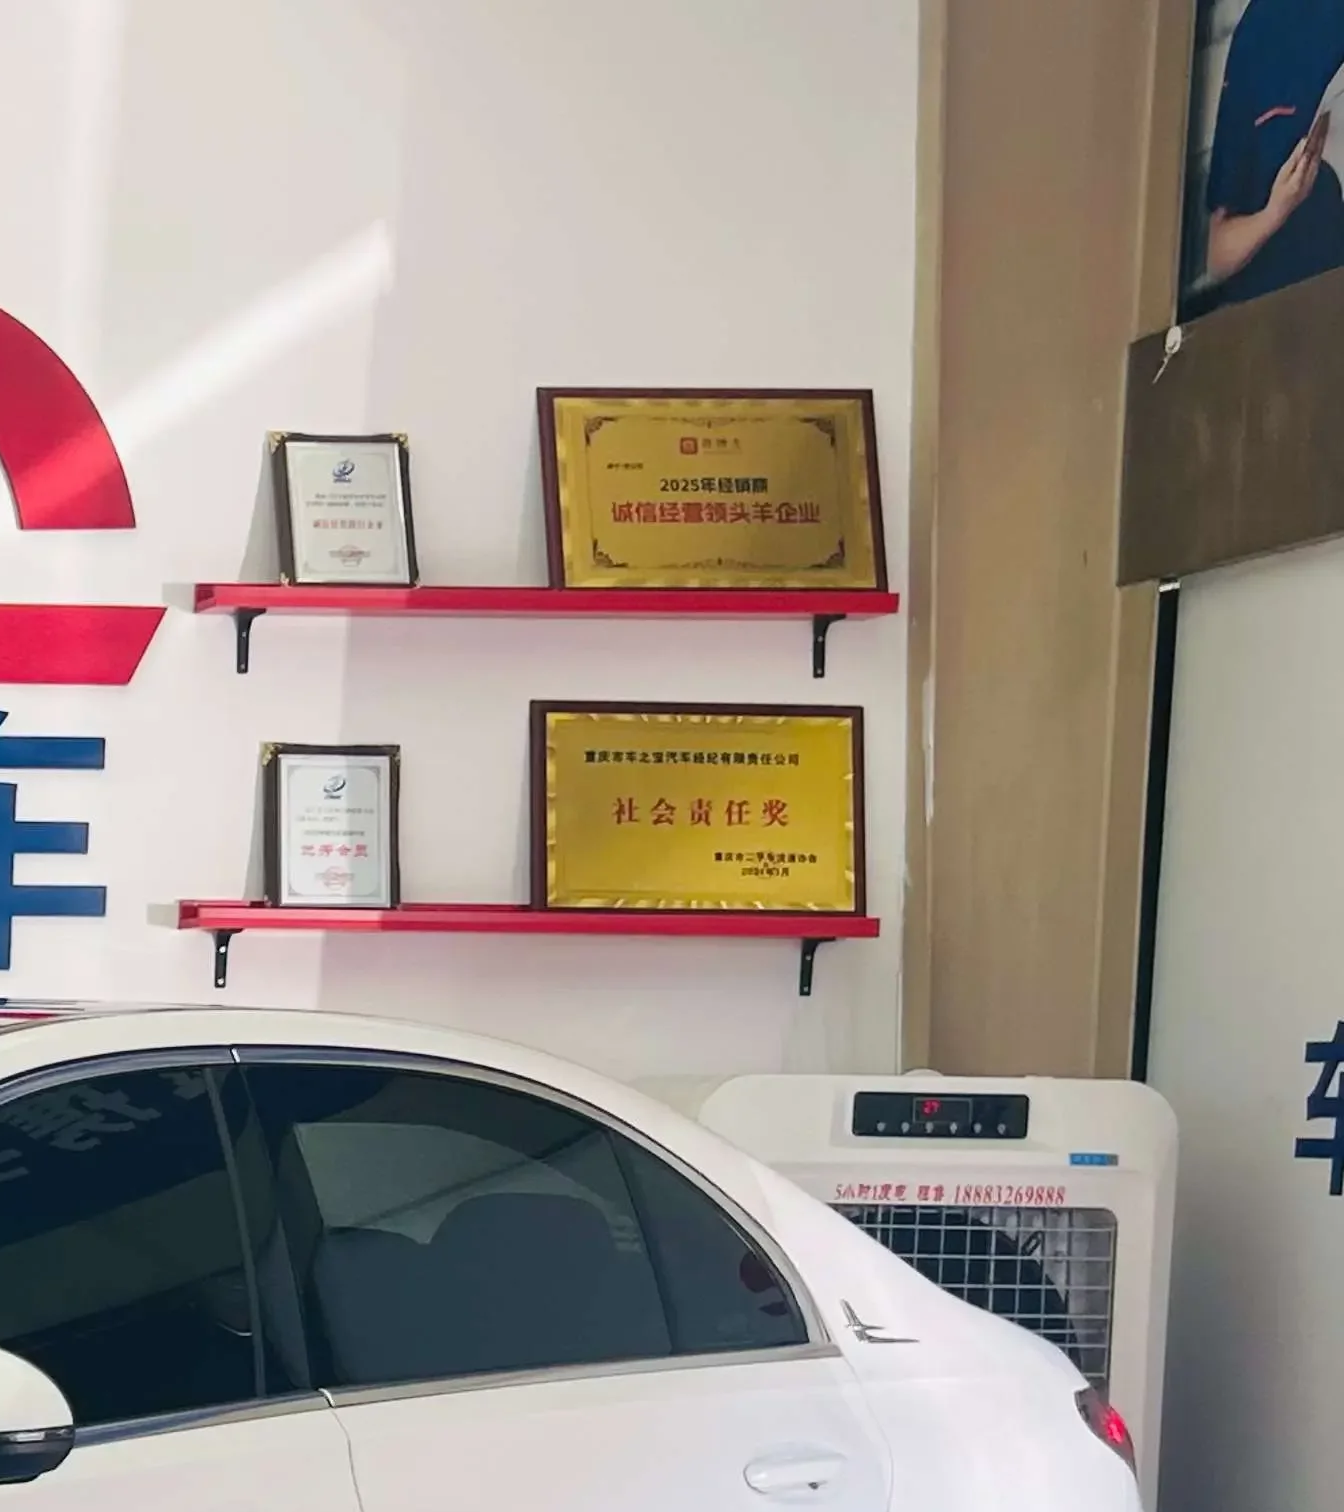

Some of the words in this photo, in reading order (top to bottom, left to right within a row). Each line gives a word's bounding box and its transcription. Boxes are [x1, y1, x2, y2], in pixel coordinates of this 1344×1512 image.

[611, 500, 821, 525] 诚信经营领头羊企业
[613, 797, 790, 828] 社会责任奖
[954, 1183, 1067, 1205] 18883269888
